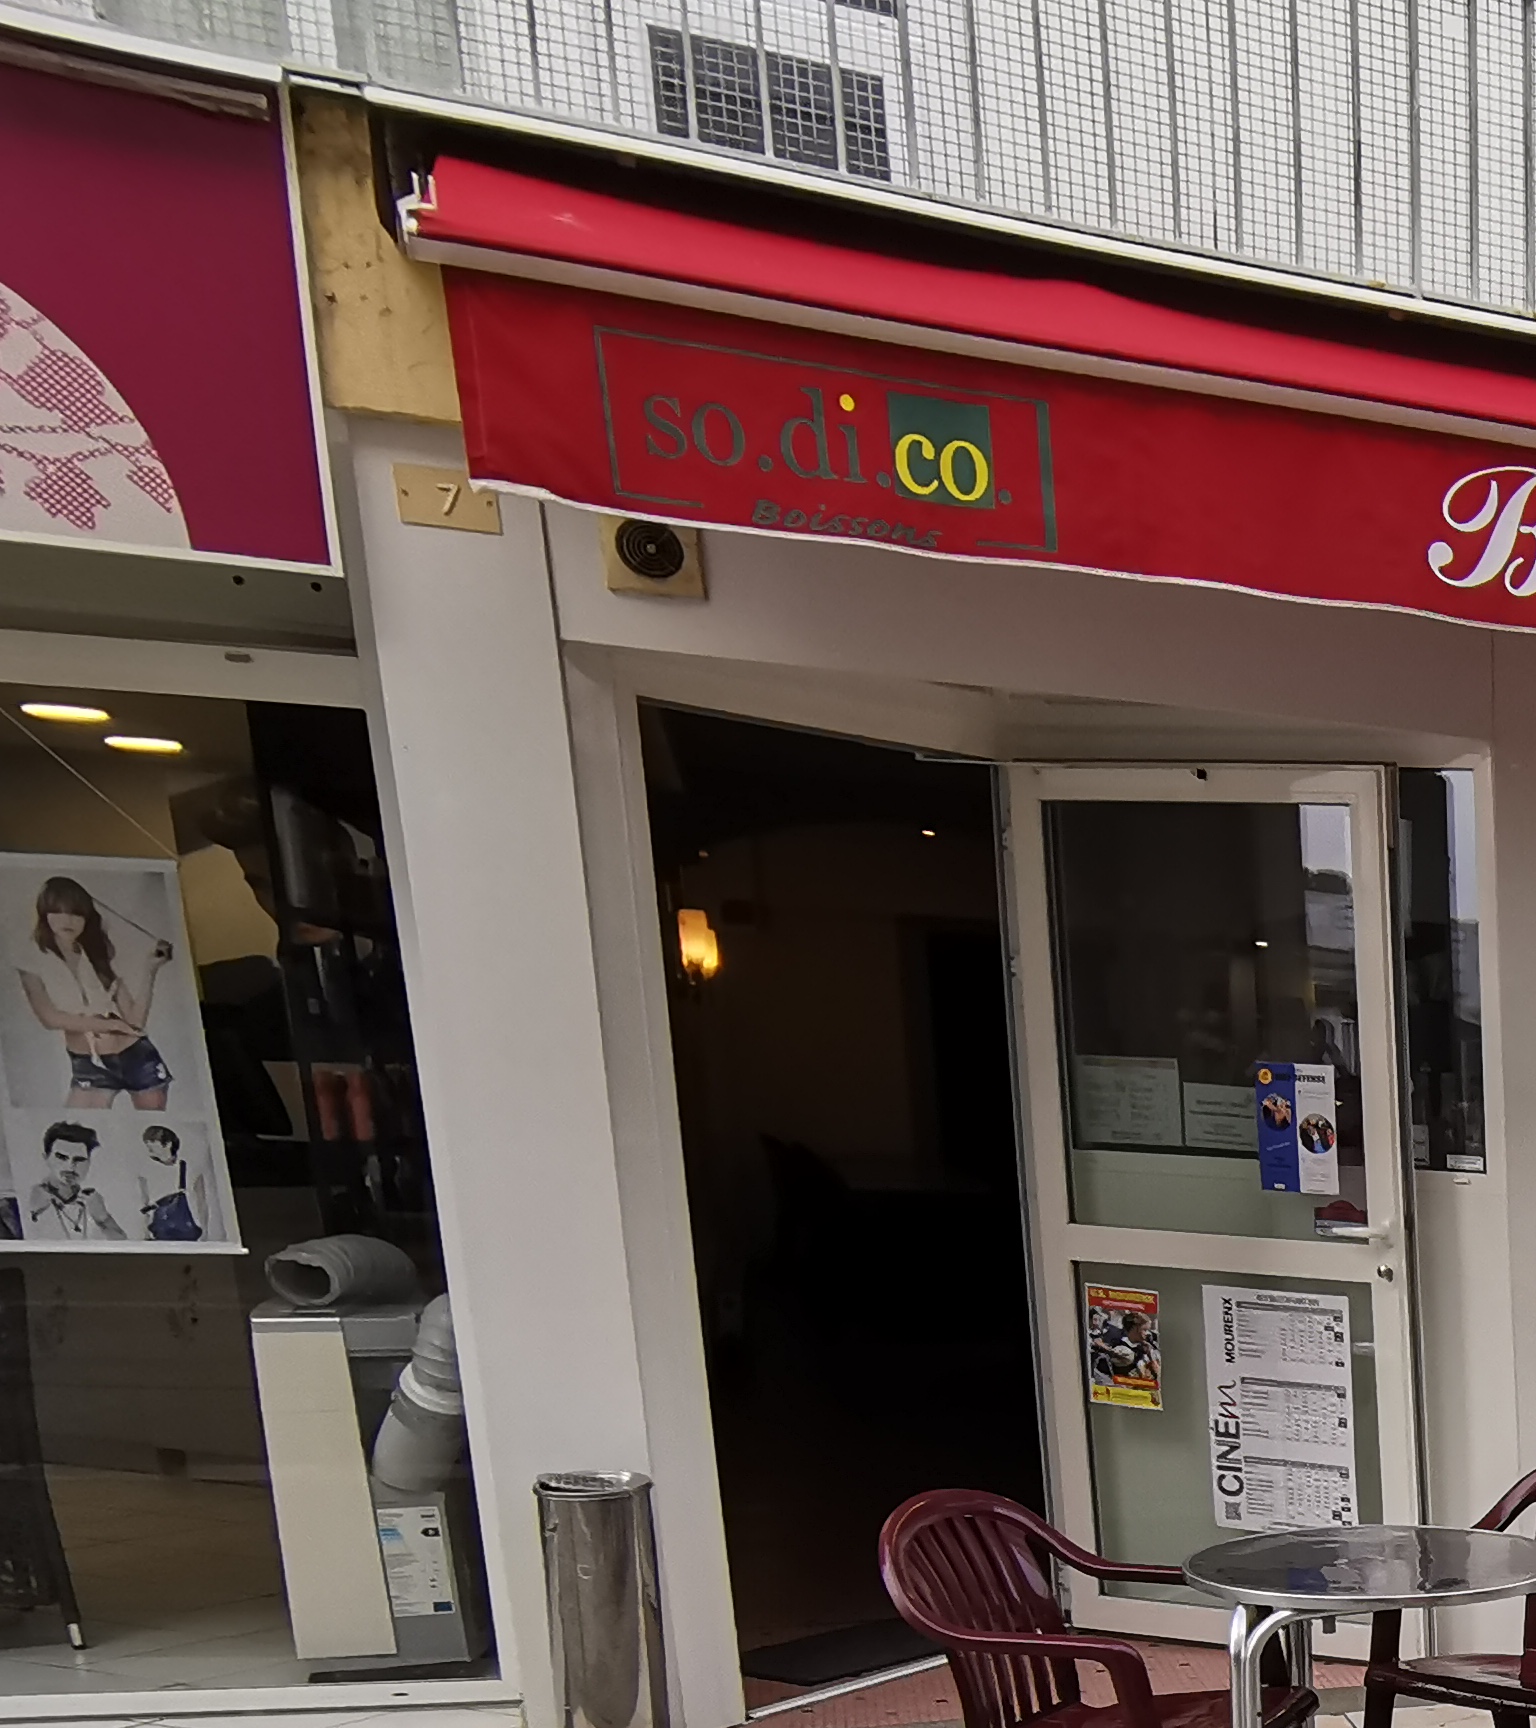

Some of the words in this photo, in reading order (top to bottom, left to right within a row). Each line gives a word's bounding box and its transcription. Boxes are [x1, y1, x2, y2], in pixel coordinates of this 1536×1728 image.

[436, 483, 461, 516] 7
[752, 500, 943, 547] Boissons
[1220, 1296, 1236, 1364] MOURENX
